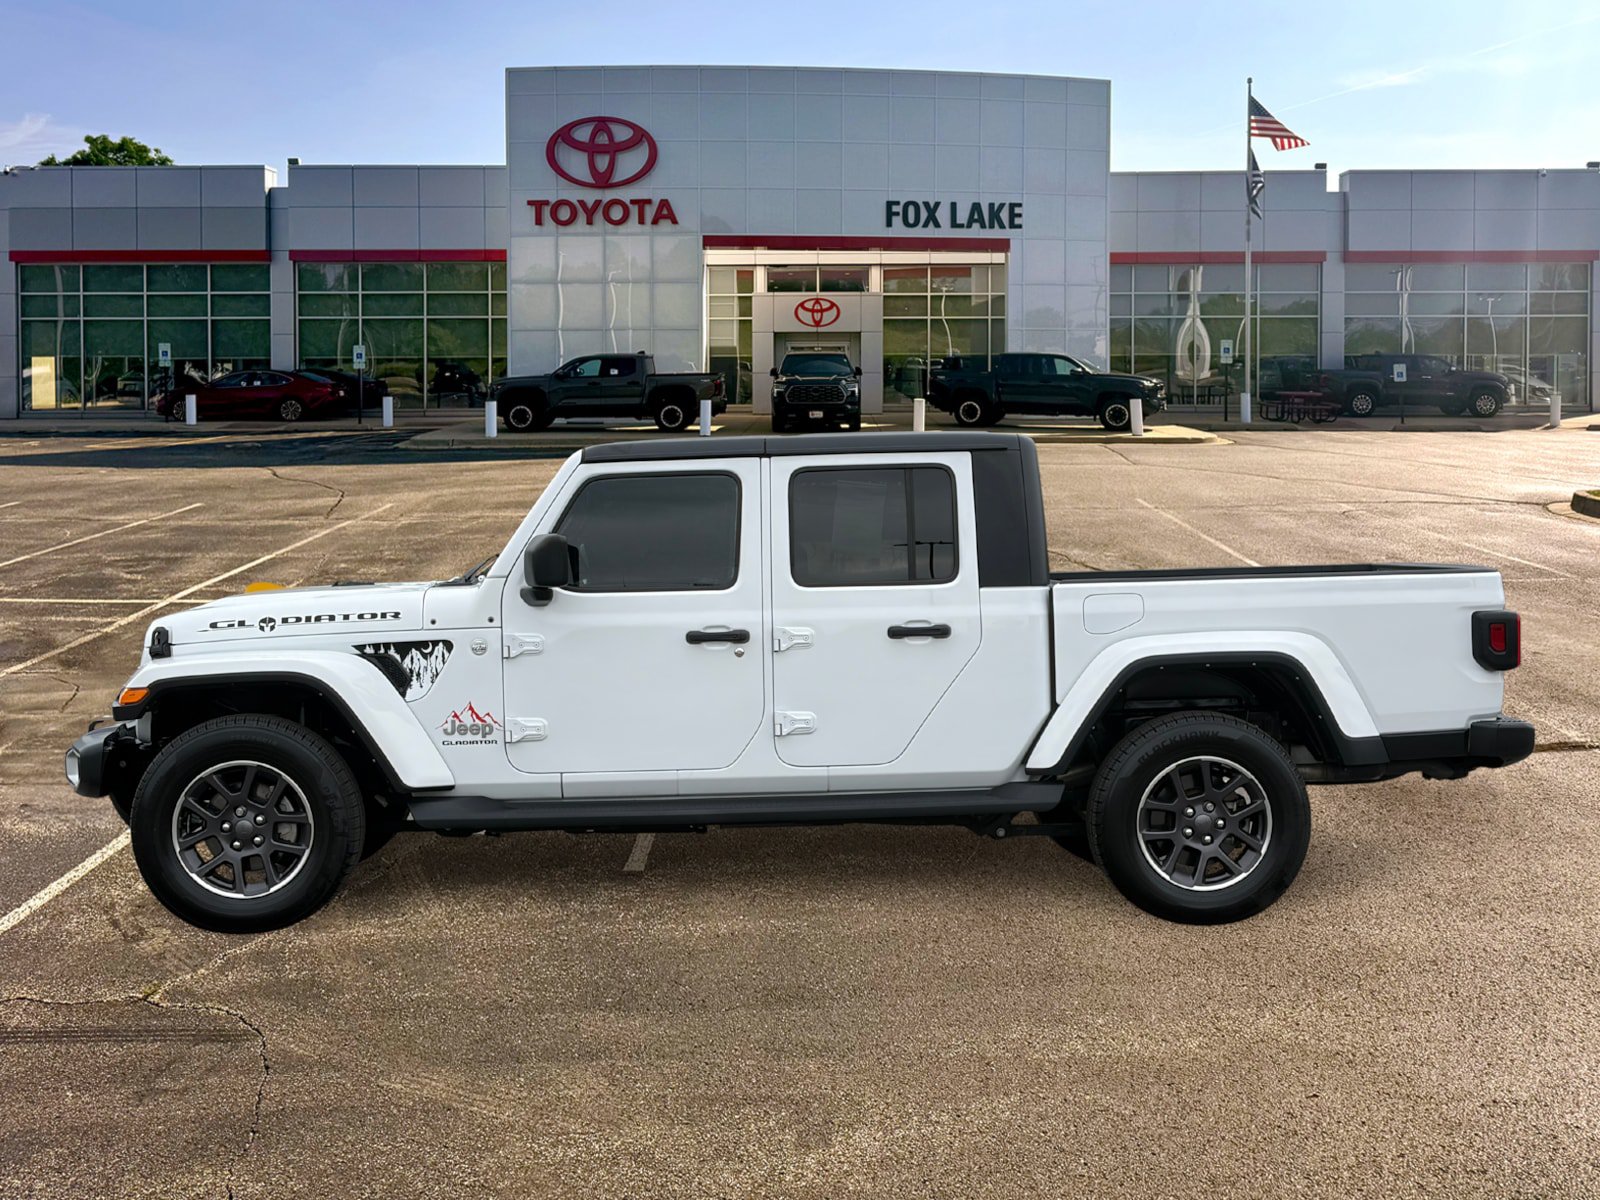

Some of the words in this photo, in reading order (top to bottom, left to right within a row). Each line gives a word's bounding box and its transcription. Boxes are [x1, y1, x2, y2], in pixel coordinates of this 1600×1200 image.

[527, 199, 679, 226] TOYOTA
[885, 200, 942, 228] FOX
[950, 201, 1023, 229] LAKE
[443, 719, 494, 739] Jeep
[1137, 730, 1220, 764] BLACKHAWK
